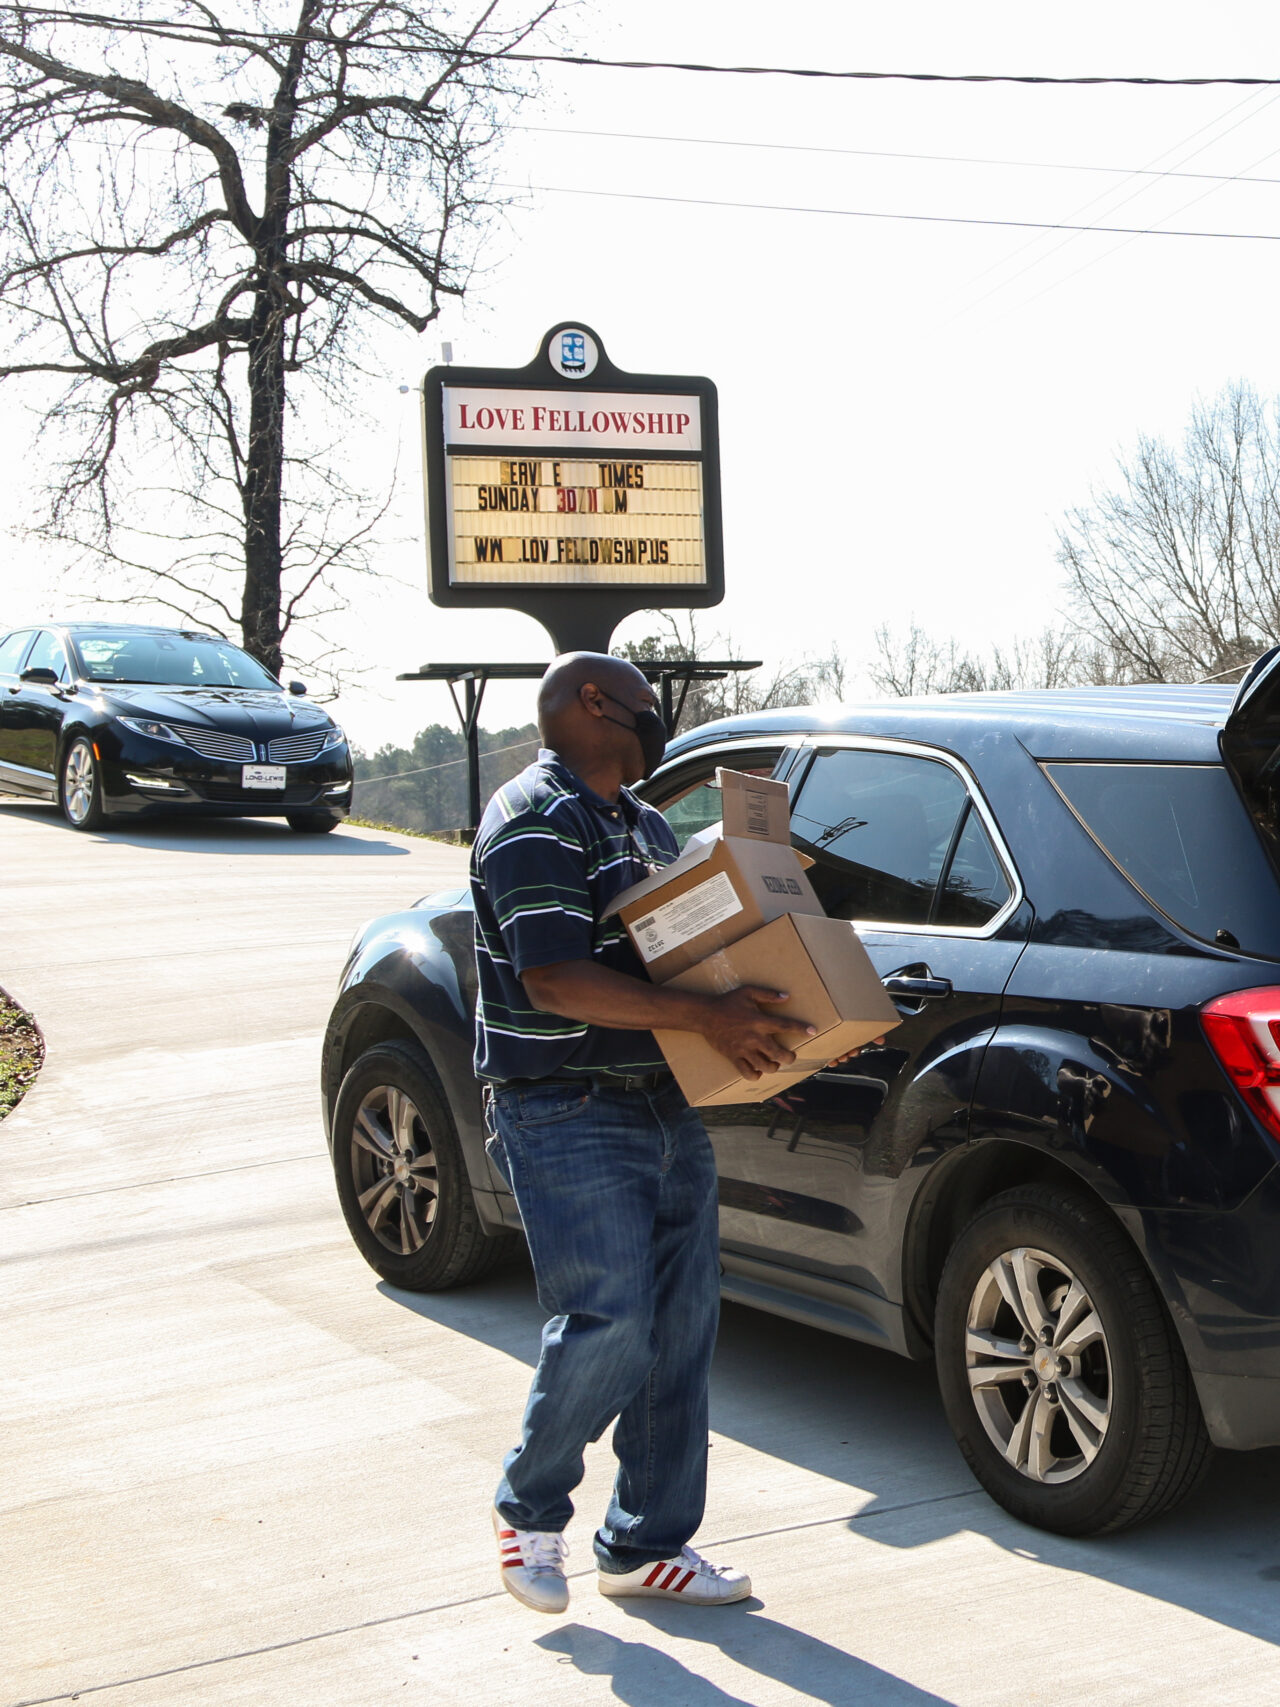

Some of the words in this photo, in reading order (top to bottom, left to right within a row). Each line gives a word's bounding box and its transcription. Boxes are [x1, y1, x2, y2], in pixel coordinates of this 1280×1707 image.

[458, 403, 525, 431] LOVE
[531, 406, 690, 435] FELLOWSHIP
[598, 463, 644, 489] TIMES
[477, 486, 539, 512] SUNDAY
